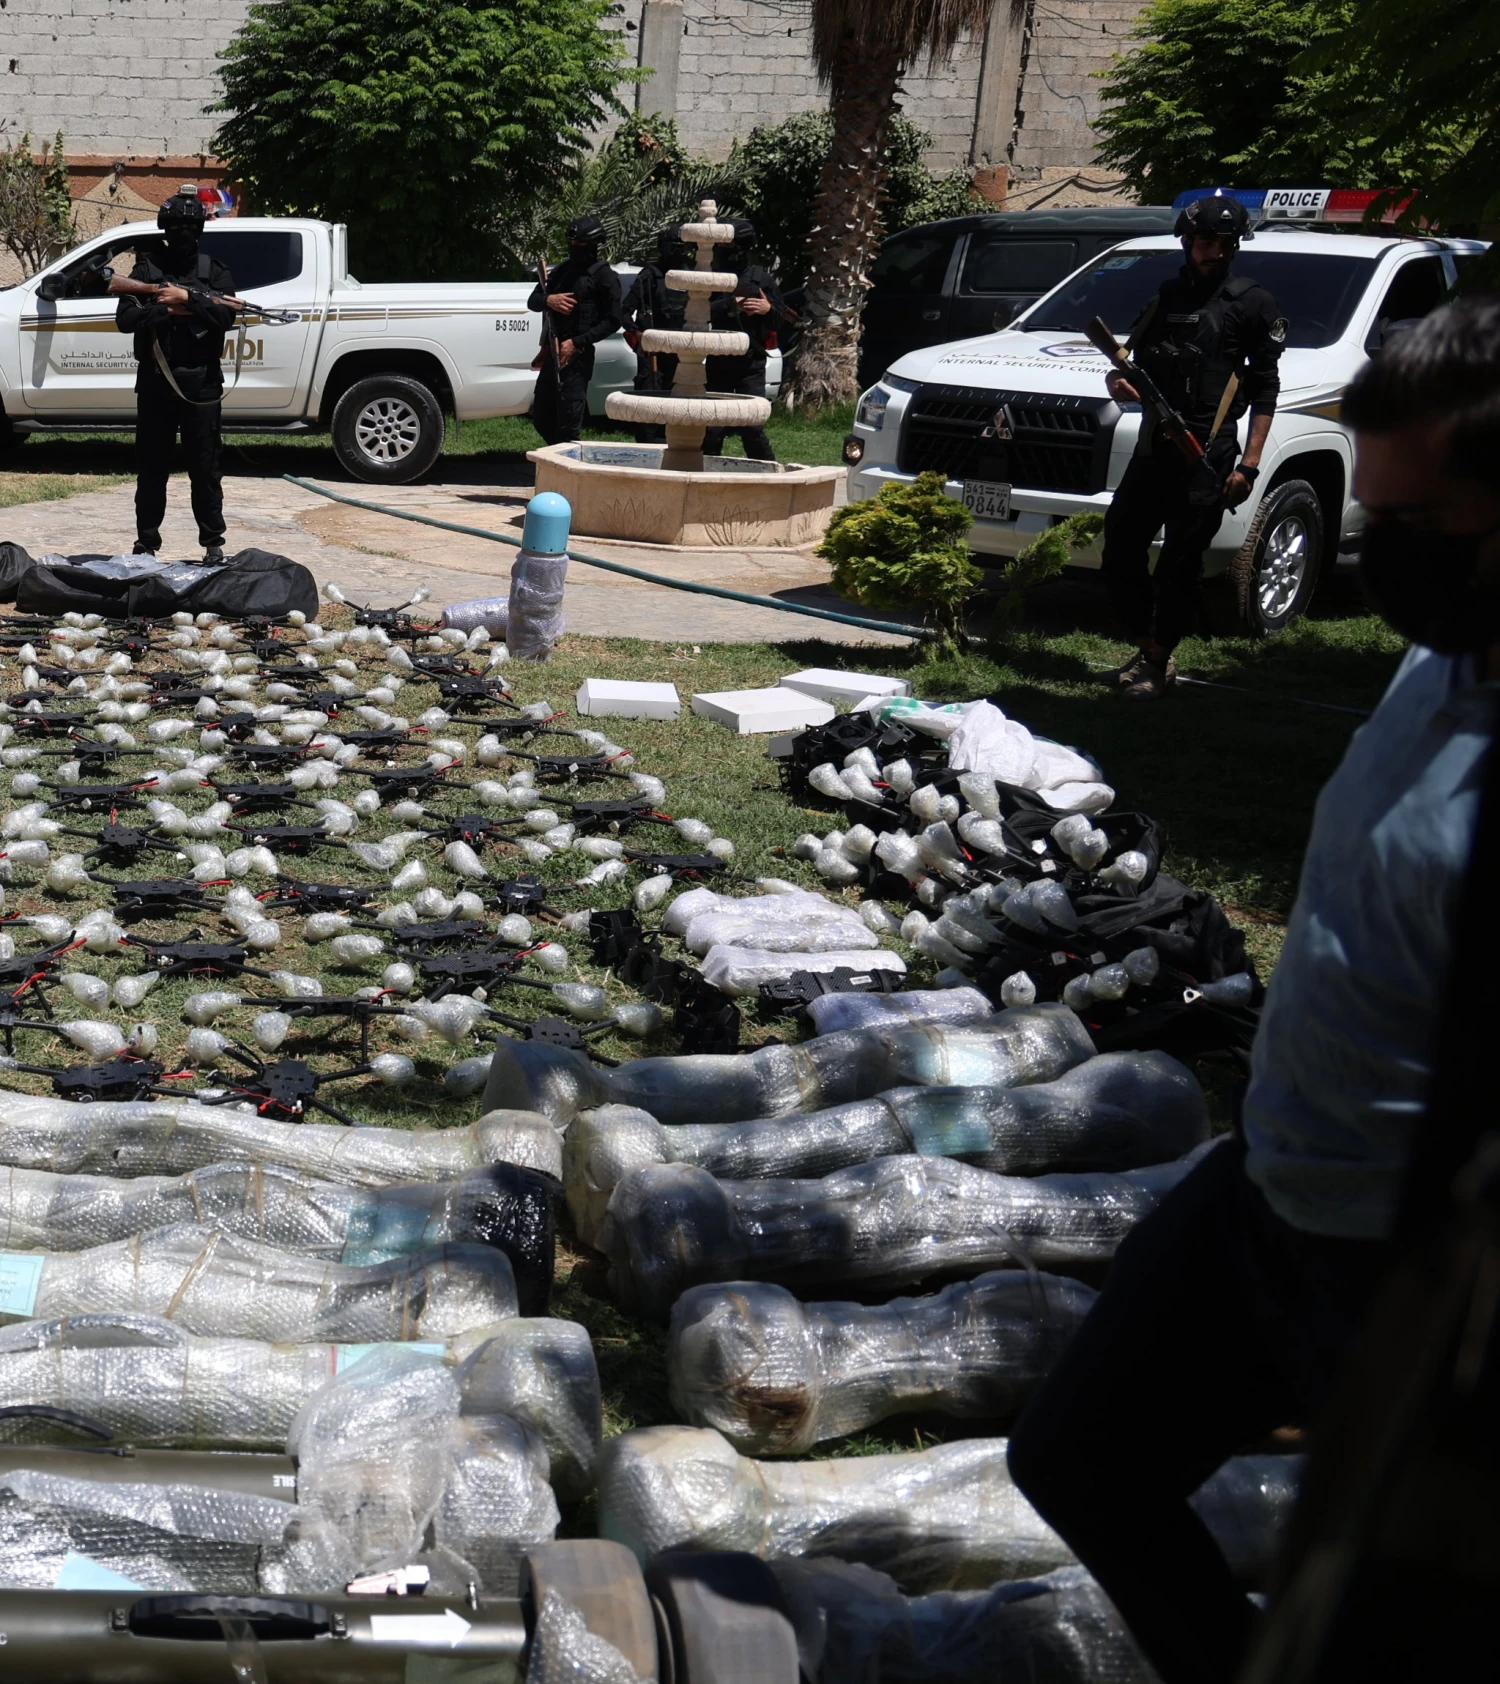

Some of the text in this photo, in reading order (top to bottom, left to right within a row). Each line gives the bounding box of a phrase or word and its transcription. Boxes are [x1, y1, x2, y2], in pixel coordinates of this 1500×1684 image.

[1270, 193, 1322, 206] POLICE
[495, 320, 530, 331] B-S 50021
[938, 358, 1109, 375] INTERNAL SECURITY COMM
[966, 495, 1006, 517] 9844
